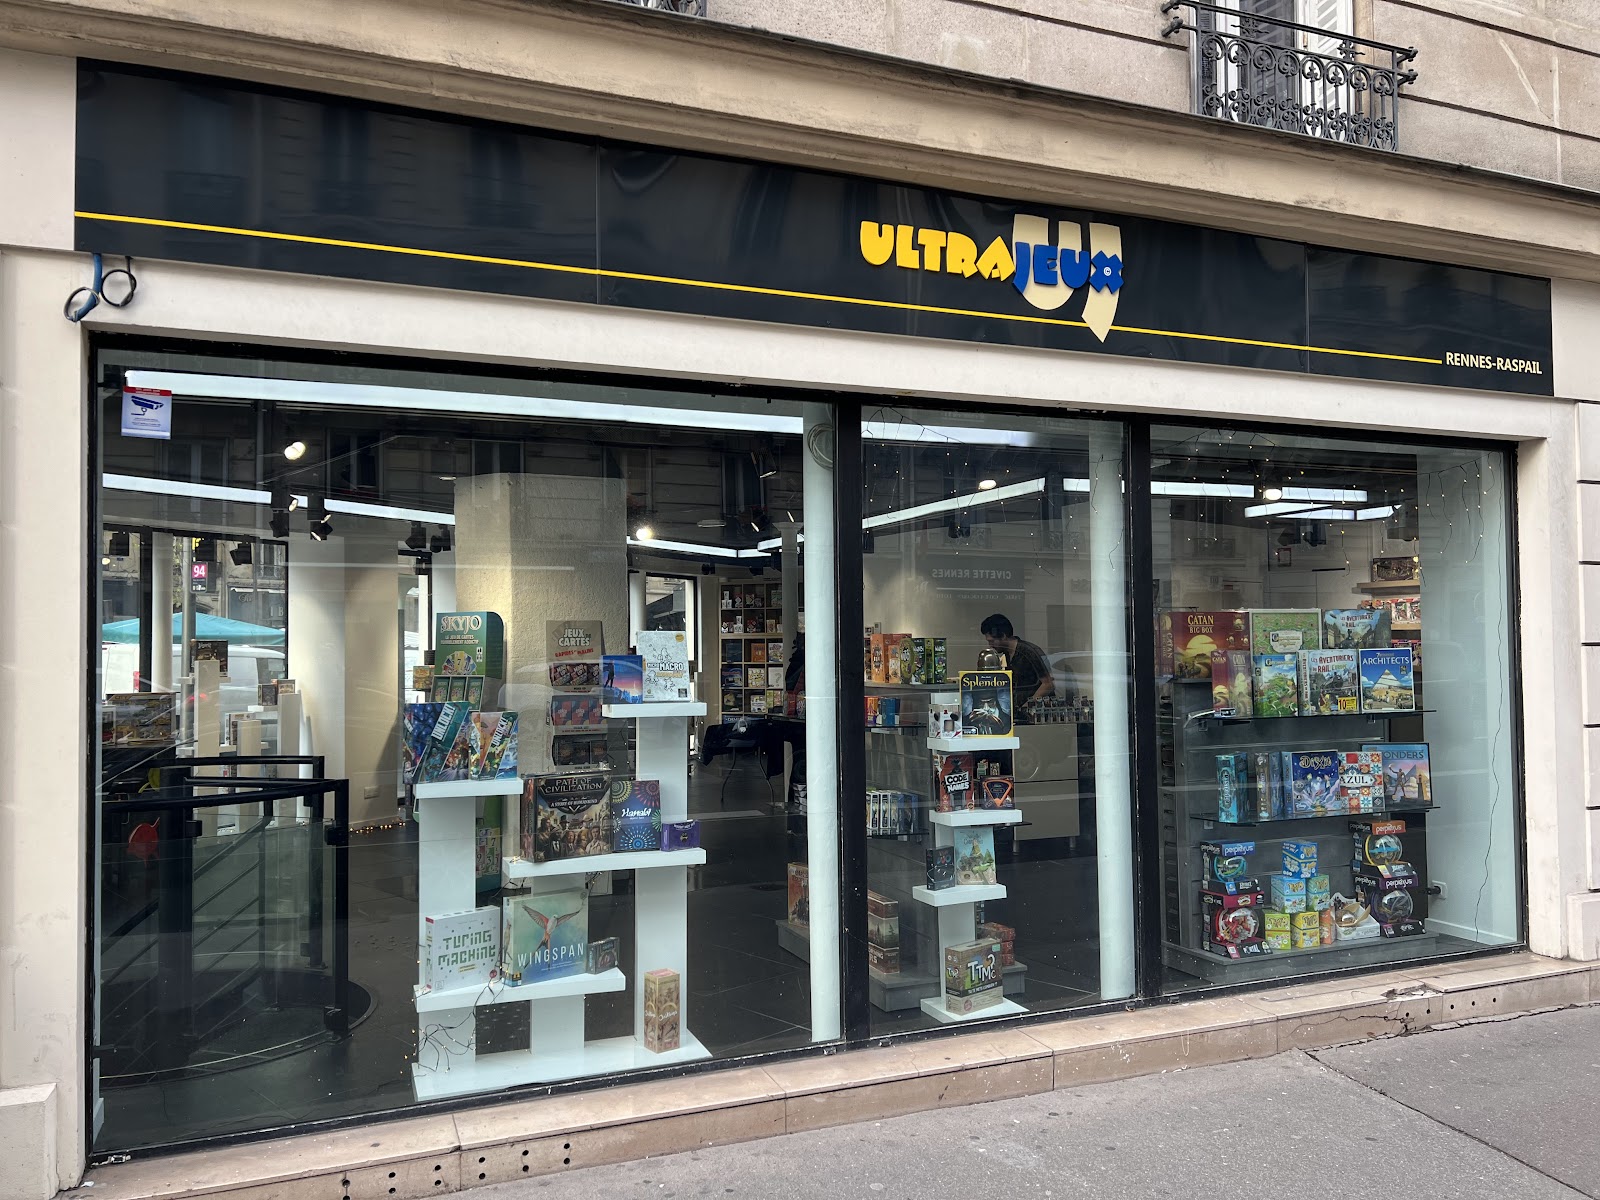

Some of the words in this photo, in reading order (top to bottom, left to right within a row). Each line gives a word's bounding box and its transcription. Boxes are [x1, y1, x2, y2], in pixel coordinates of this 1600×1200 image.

[1445, 351, 1543, 375] RENNES-RASPAIL
[193, 565, 206, 577] 94
[440, 615, 482, 634] SKYJO
[1187, 614, 1214, 625] CATAN
[563, 628, 584, 638] JEUX
[558, 637, 590, 647] CARTES
[1319, 655, 1354, 664] AVENTURIERS
[1362, 656, 1410, 665] ARCHITECTS
[659, 662, 684, 671] MACRO
[1317, 665, 1330, 673] RAIL
[962, 675, 1008, 691] Splendor
[1338, 699, 1347, 709] 10
[430, 703, 456, 741] UNLOCK!
[1381, 750, 1424, 760] ONDERS
[580, 777, 592, 785] OF
[946, 773, 968, 784] CODE
[1339, 775, 1368, 784] AZUL
[545, 782, 602, 793] CIVILIZATION
[946, 782, 970, 793] NAMES
[517, 942, 585, 968] WINGSPAN
